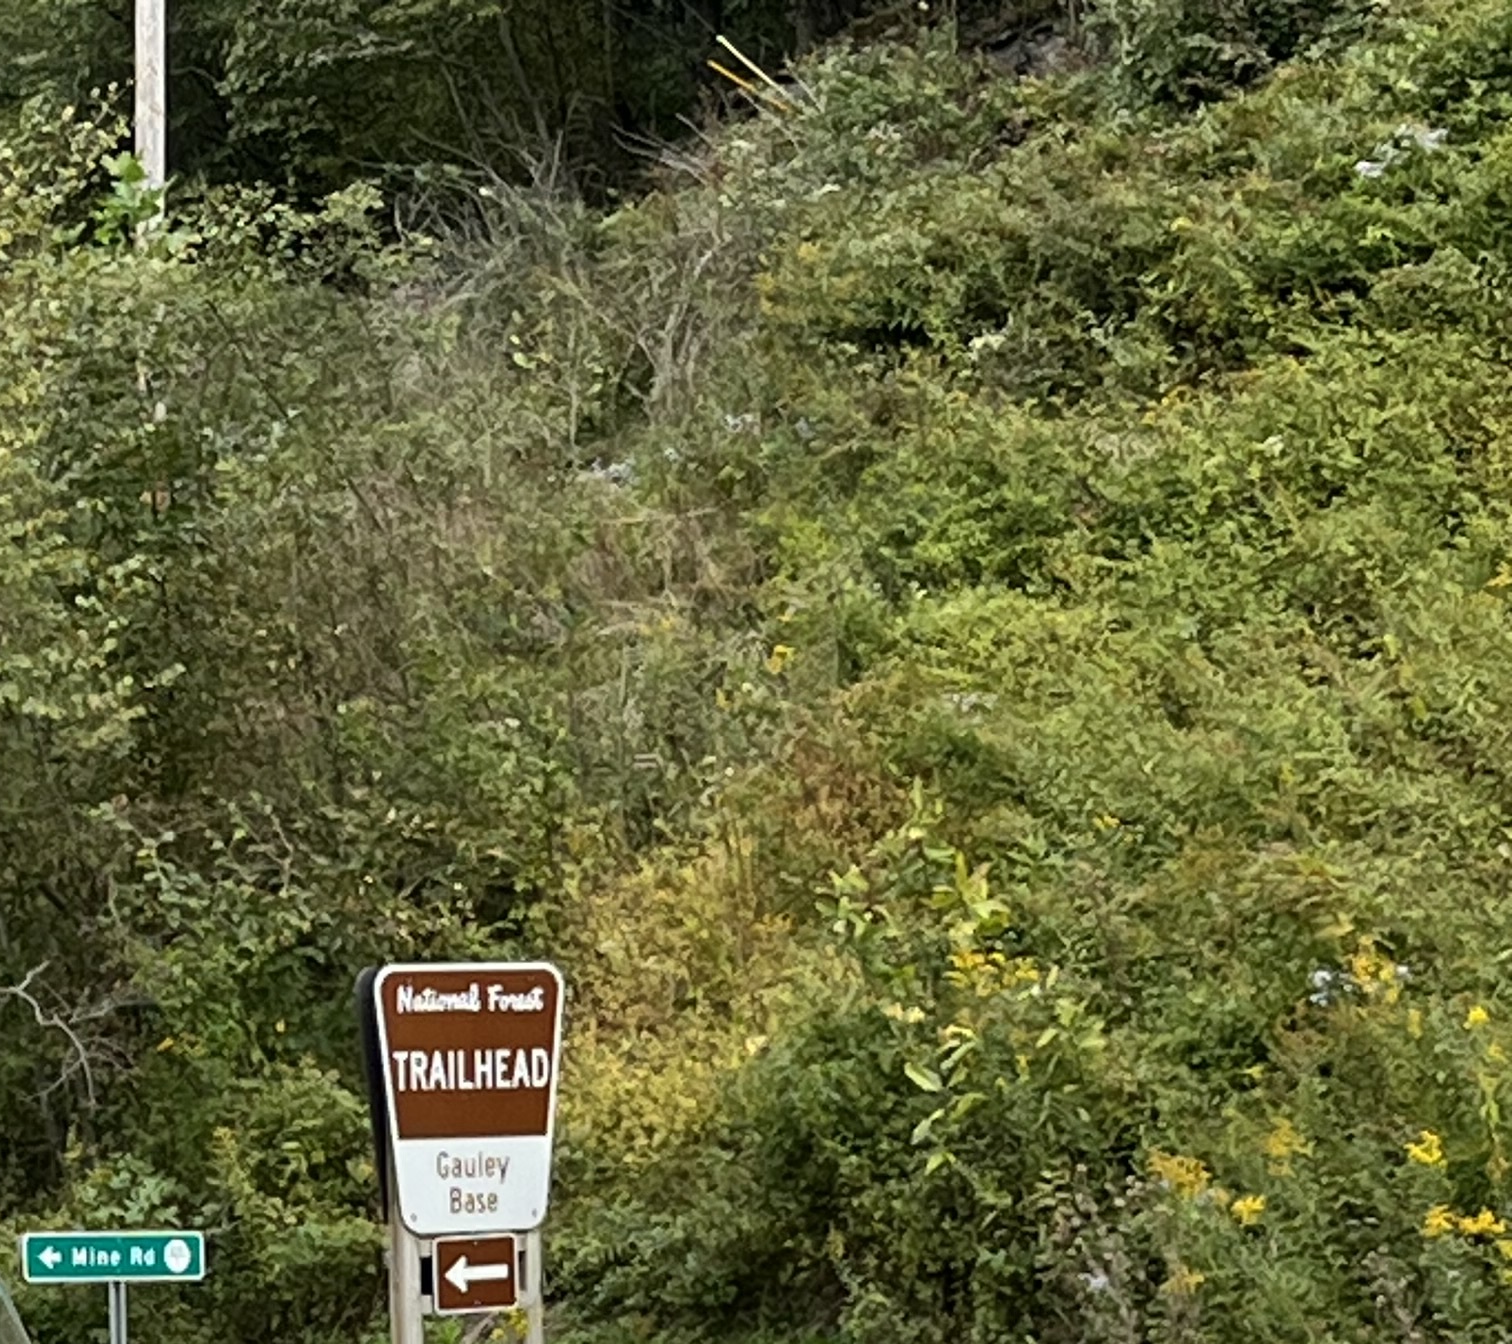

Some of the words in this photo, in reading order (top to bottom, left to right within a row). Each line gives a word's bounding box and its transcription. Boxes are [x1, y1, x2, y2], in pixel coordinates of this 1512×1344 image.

[396, 982, 482, 1015] National
[486, 983, 545, 1013] Forest
[392, 1048, 550, 1092] TRAILHEAD
[435, 1150, 511, 1185] Gauley
[449, 1186, 499, 1215] Base
[71, 1245, 122, 1268] Mine
[129, 1245, 157, 1267] Rd
